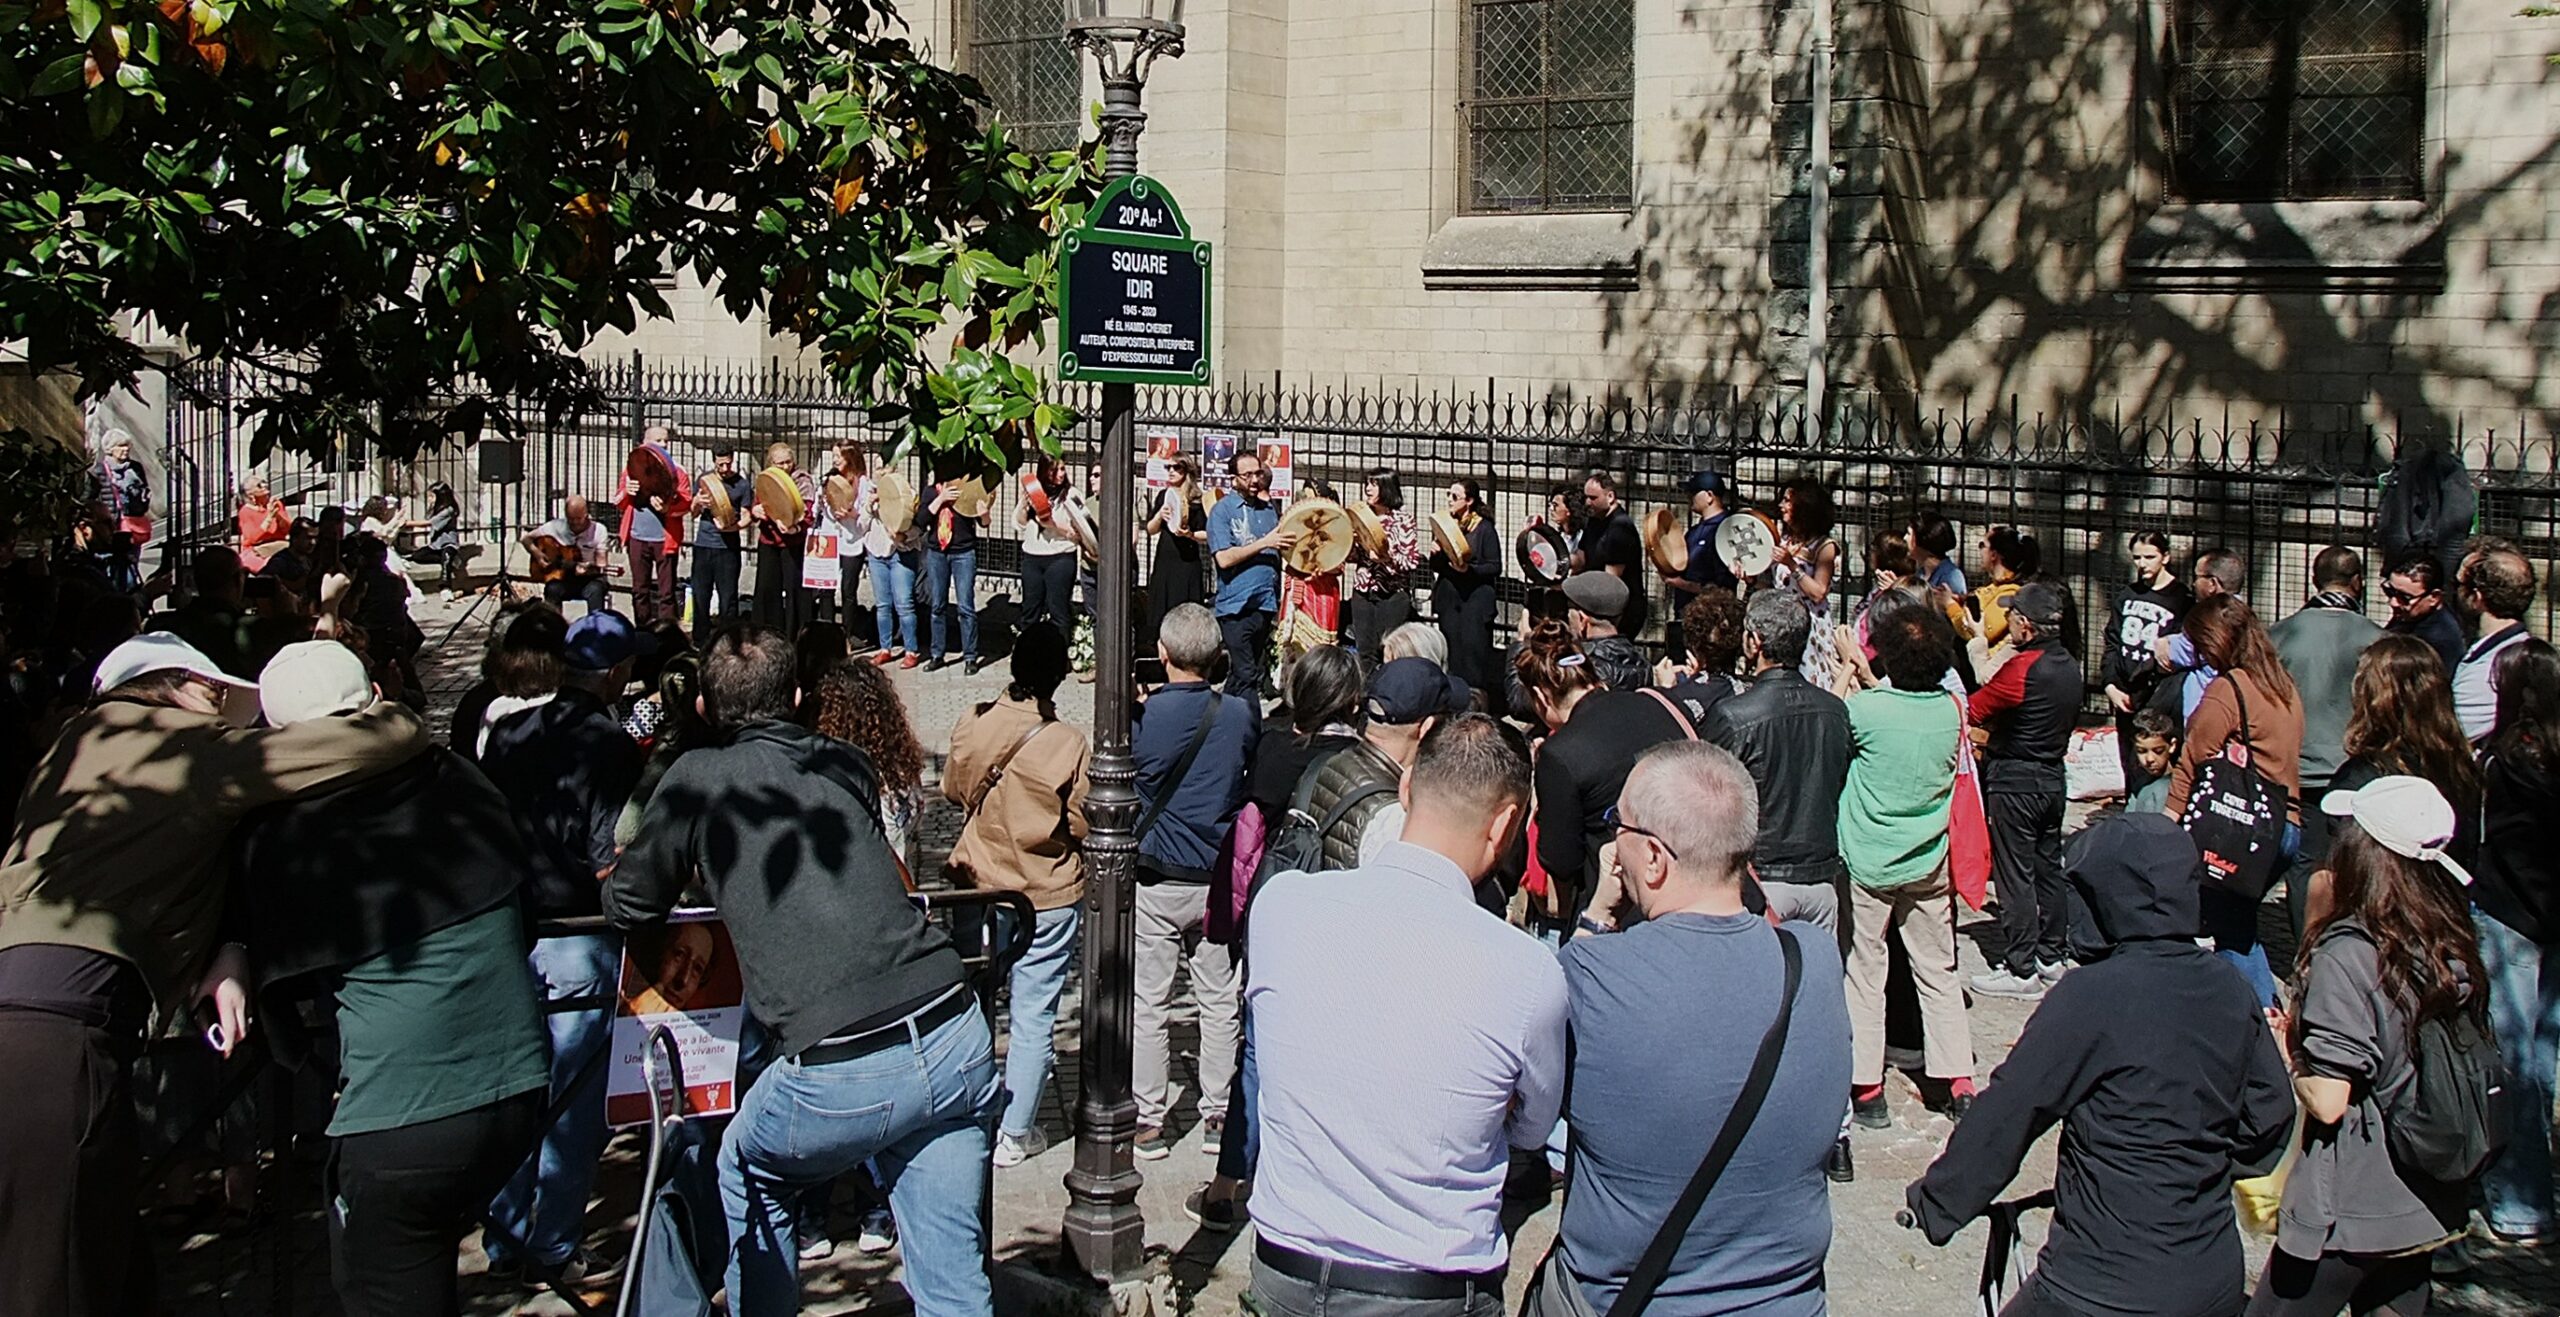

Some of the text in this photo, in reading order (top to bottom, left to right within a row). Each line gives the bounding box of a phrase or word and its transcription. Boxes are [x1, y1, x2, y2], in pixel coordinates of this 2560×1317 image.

[1119, 205, 1140, 225] 20e
[1112, 251, 1168, 275] SQUARE
[1126, 278, 1153, 299] IDIR
[1123, 305, 1137, 316] 1945
[1142, 306, 1157, 317] 2020
[1104, 317, 1114, 331] NÉ
[1115, 321, 1124, 331] EL
[1145, 322, 1173, 334] CHERIET
[1080, 334, 1195, 351] AUTEUR, COMPOSITEUR, INTERPRÈTE
[1102, 350, 1174, 365] D'EXPRESSION KABYLE
[2121, 616, 2159, 651] 84
[2222, 791, 2248, 811] COME
[2209, 799, 2255, 826] TOGETHER
[692, 1045, 726, 1057] vivante
